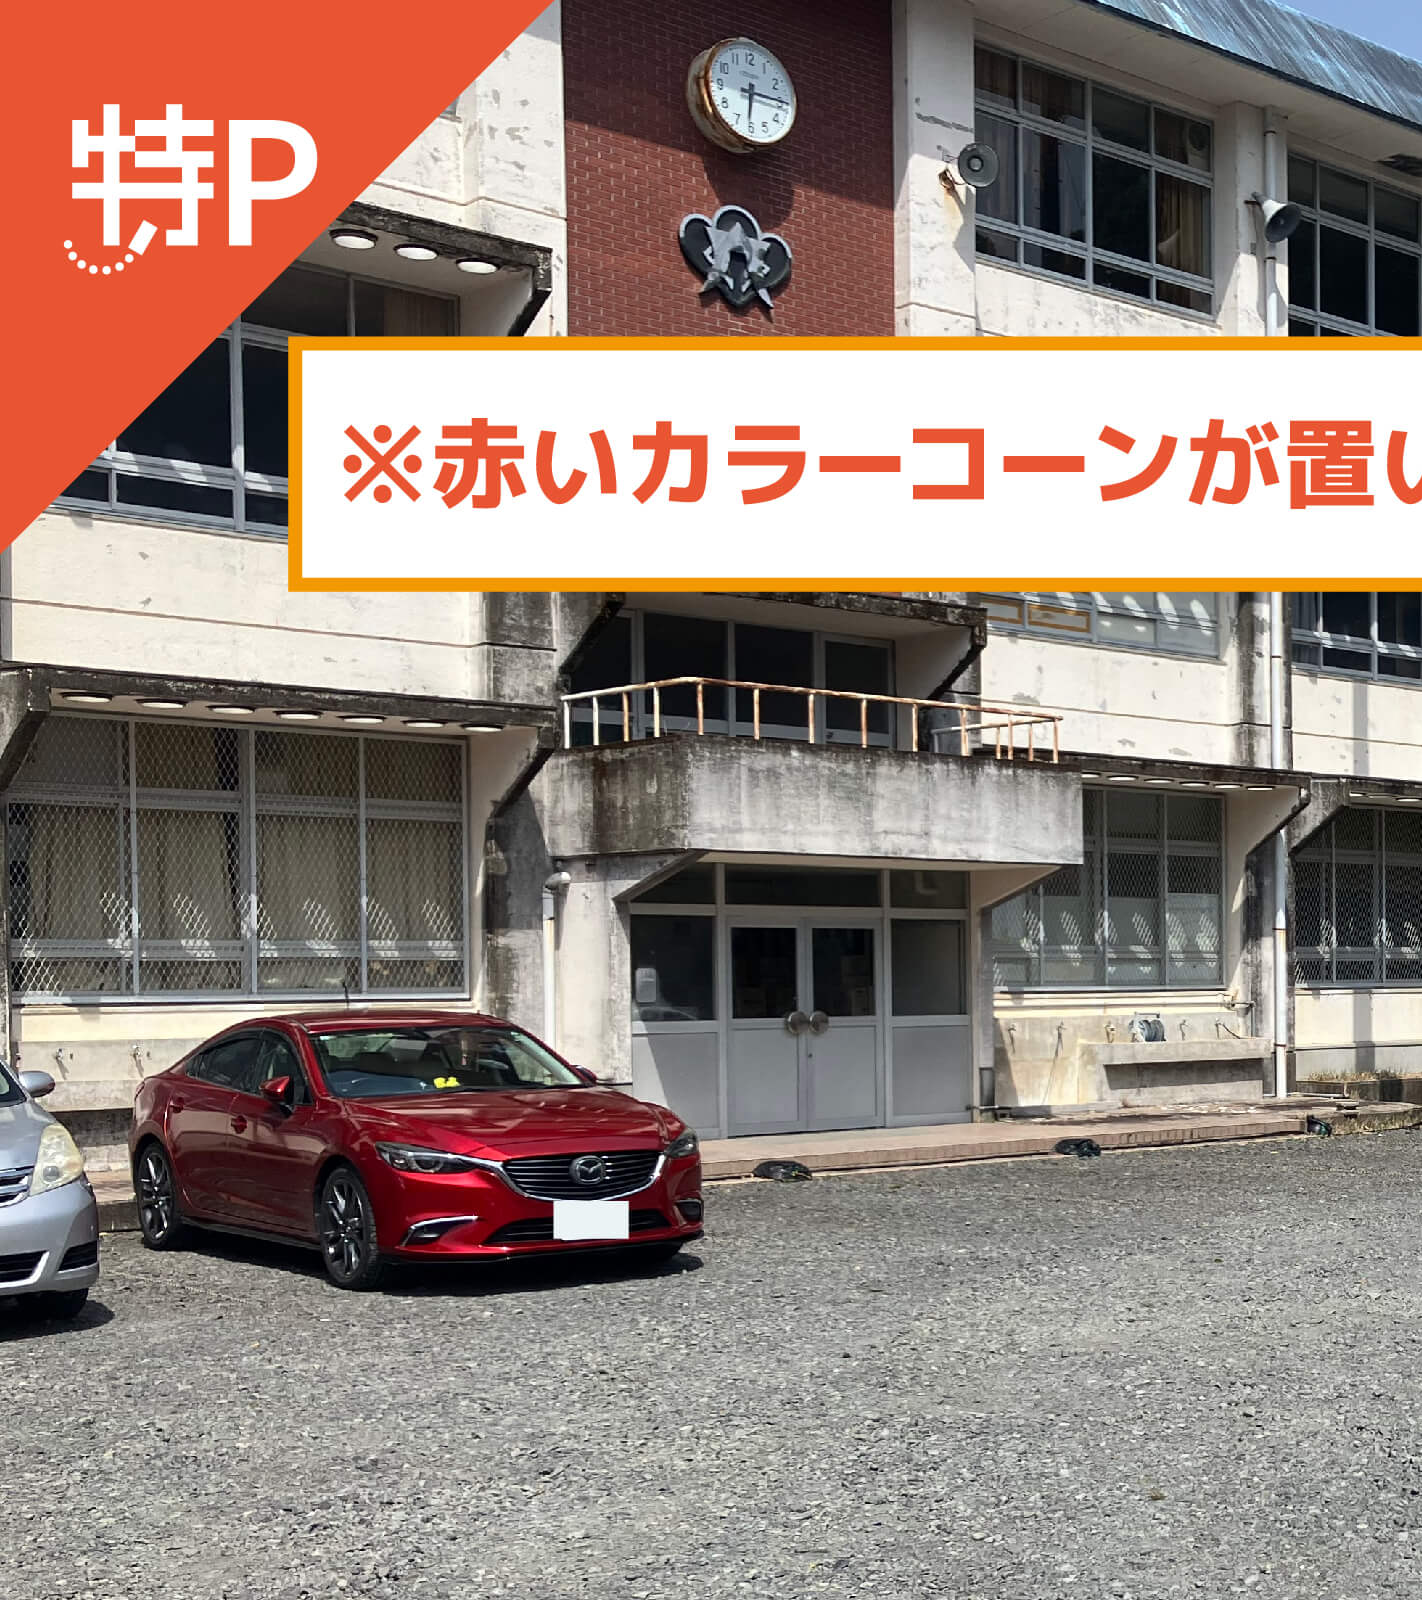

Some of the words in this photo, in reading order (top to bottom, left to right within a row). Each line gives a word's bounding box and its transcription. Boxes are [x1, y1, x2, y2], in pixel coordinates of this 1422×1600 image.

[731, 53, 739, 66] 11
[745, 52, 755, 66] 12
[720, 62, 729, 75] 10
[716, 78, 724, 91] 9
[772, 78, 779, 91] 2
[721, 96, 729, 109] 8
[732, 112, 741, 125] 7
[772, 112, 780, 124] 4
[748, 121, 755, 134] 6
[761, 121, 769, 134] 5
